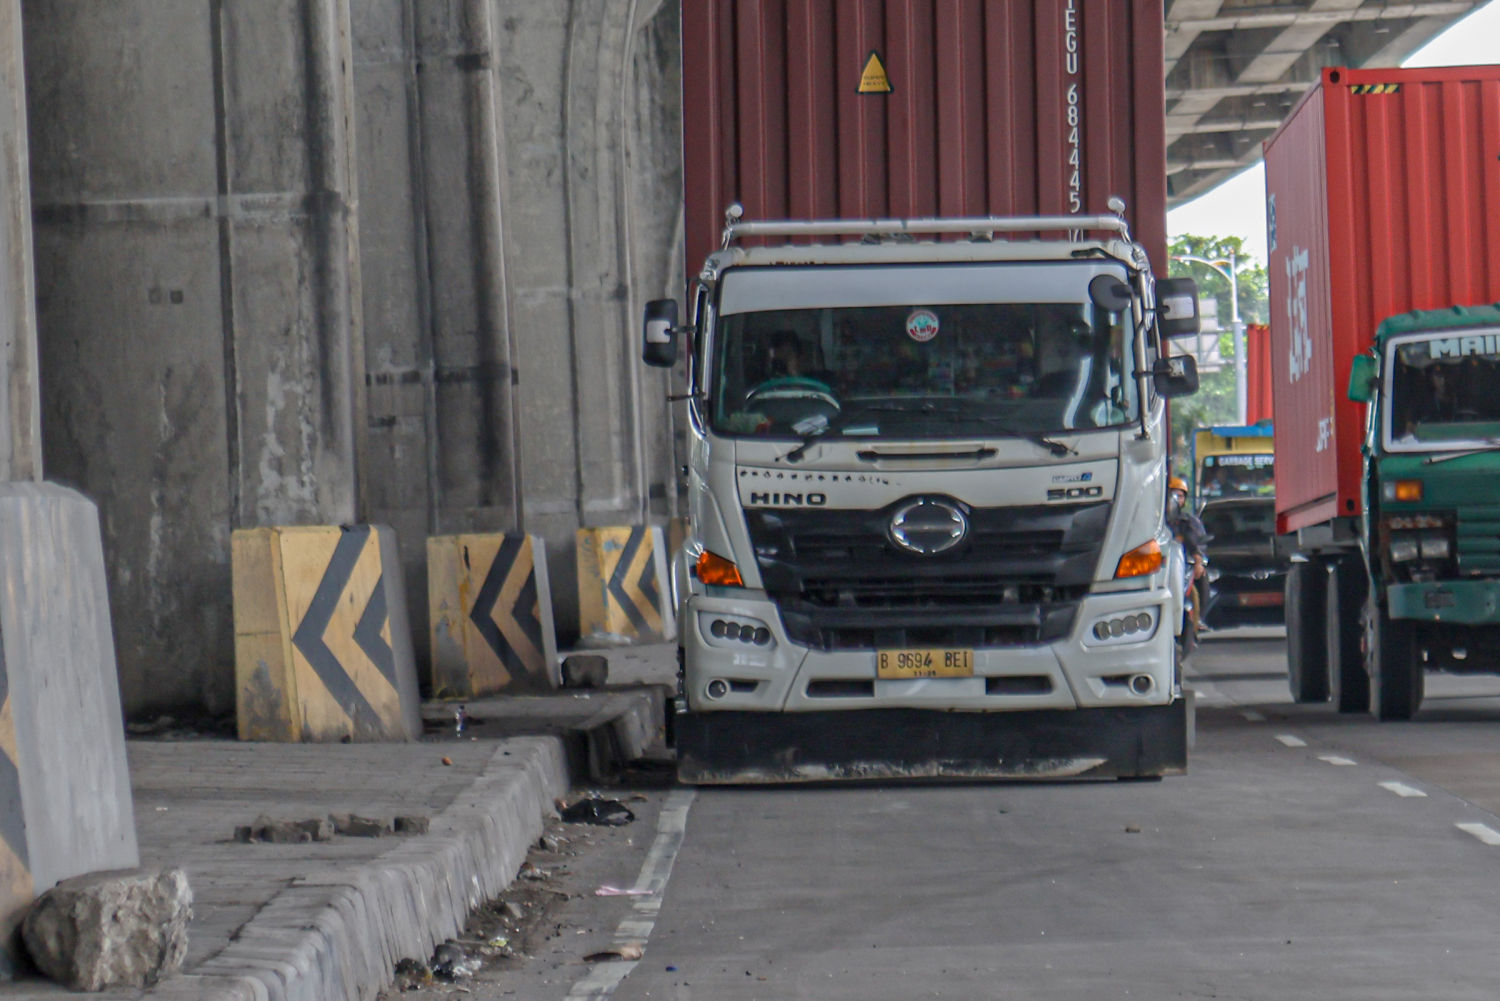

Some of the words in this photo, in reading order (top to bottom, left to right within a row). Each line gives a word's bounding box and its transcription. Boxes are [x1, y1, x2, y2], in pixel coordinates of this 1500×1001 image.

[1067, 84, 1081, 213] 684445
[751, 493, 826, 505] HINO
[1047, 486, 1103, 500] 500
[880, 653, 889, 669] B
[897, 652, 932, 669] 9694
